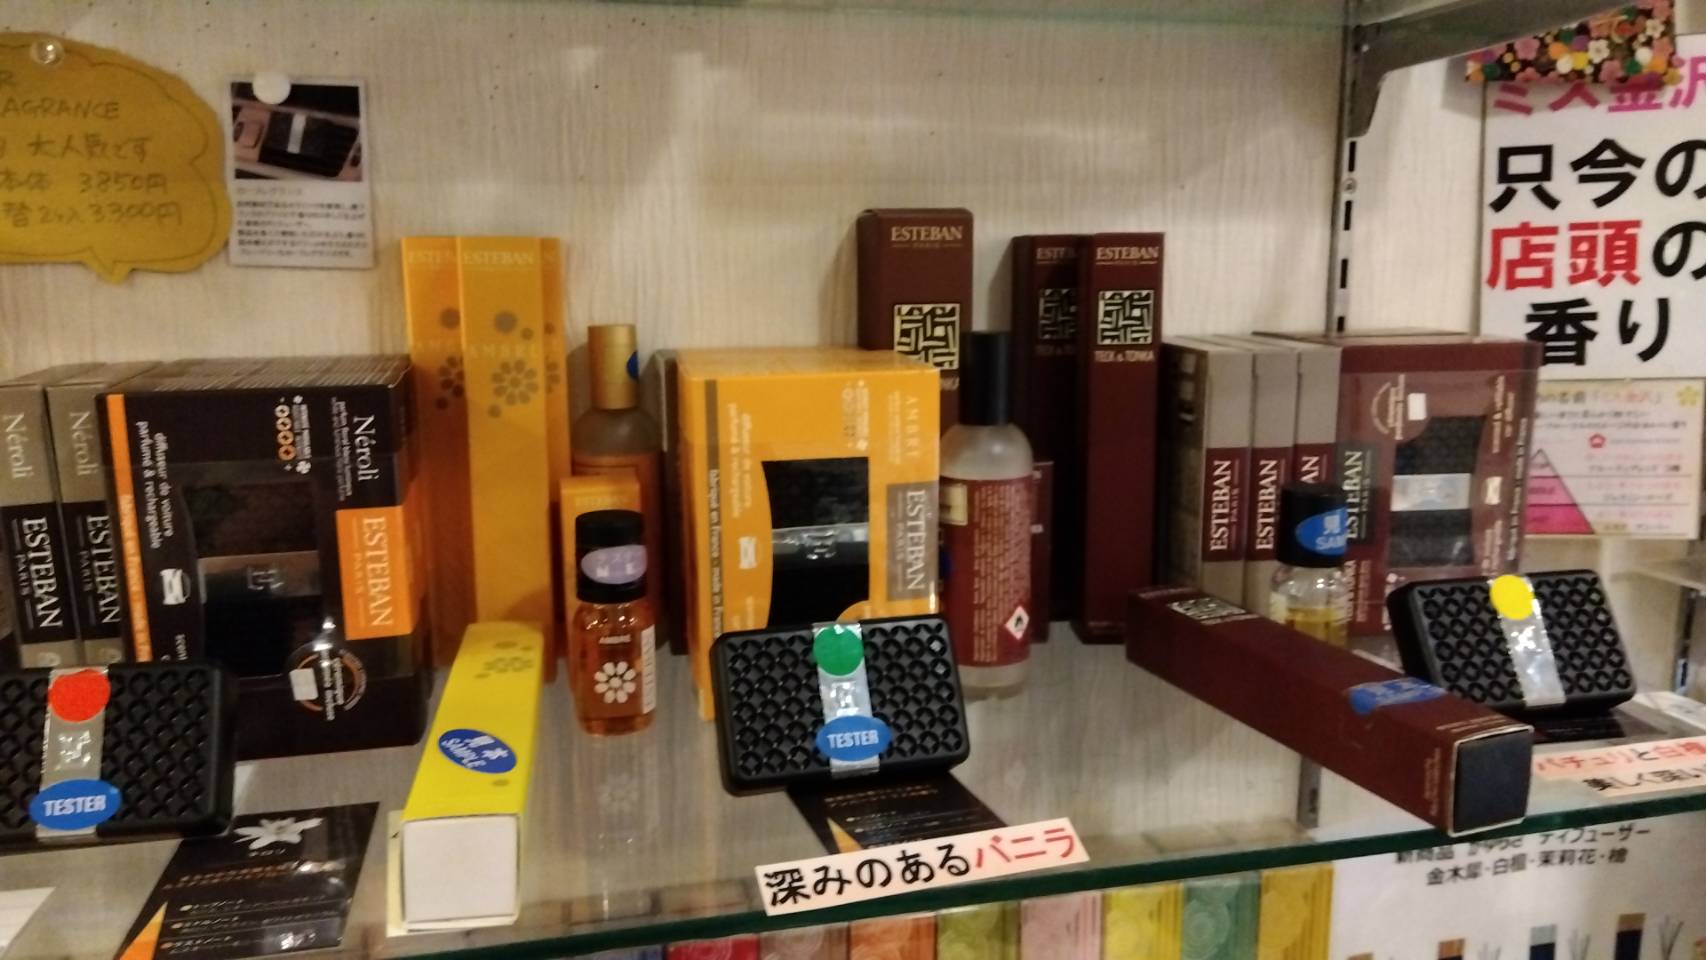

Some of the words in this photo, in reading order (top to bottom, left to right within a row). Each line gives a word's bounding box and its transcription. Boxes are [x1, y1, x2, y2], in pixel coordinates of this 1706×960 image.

[891, 225, 963, 241] ESTEBAN
[1096, 247, 1159, 260] ESTEBAN
[1525, 298, 1670, 367] 香り
[4, 412, 34, 479] Néroli
[70, 411, 99, 476] Néroli
[353, 415, 380, 481] Néroli
[1210, 460, 1231, 551] ESTEBAN
[1255, 460, 1278, 550] ESTEBAN
[22, 516, 63, 627] ESTEBAN
[86, 515, 121, 624] ESTEBAN
[363, 517, 393, 627] ESTEBAN
[907, 490, 925, 590] ESTEBAN
[826, 729, 880, 749] TESTER
[42, 794, 107, 818] TESTER
[764, 826, 1076, 906] 深みのあるバニラ
